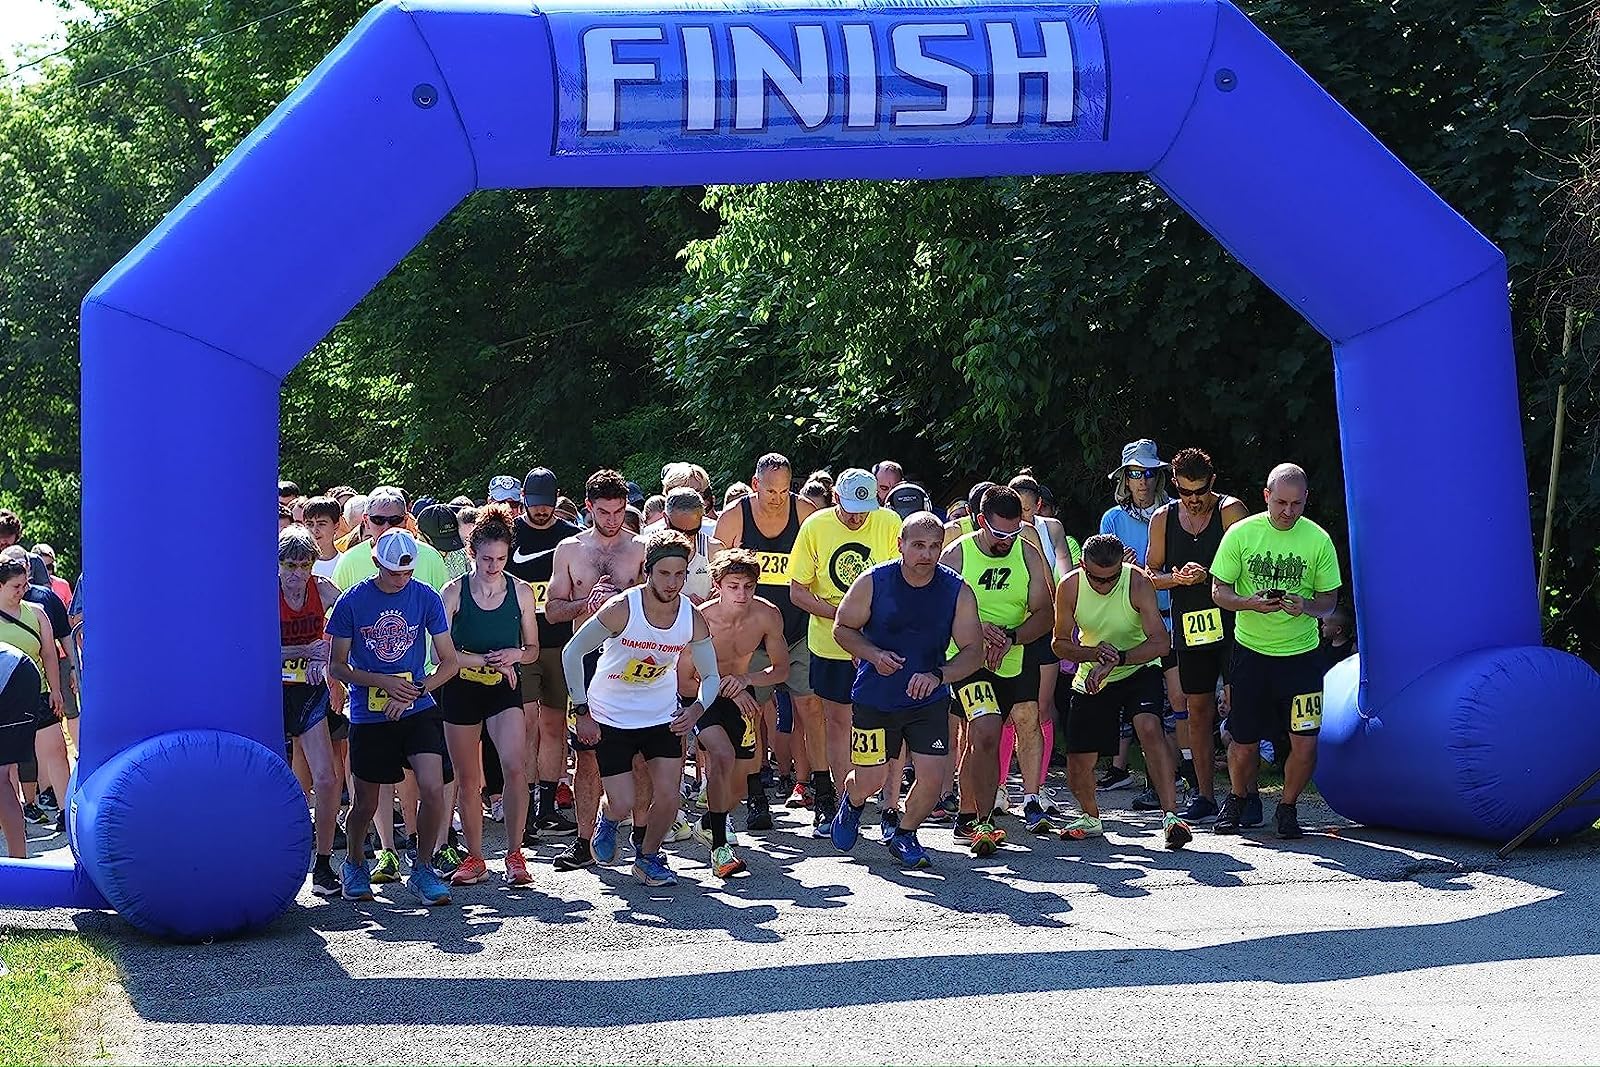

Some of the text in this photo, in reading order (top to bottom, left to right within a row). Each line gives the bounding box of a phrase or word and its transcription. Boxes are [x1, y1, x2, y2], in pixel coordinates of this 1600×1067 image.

[580, 18, 1079, 135] FINISH
[761, 555, 789, 574] 238
[1187, 612, 1217, 634] 201
[621, 637, 657, 650] DIAMOND
[964, 684, 994, 707] 144
[1295, 695, 1322, 718] 149
[852, 732, 879, 752] 231
